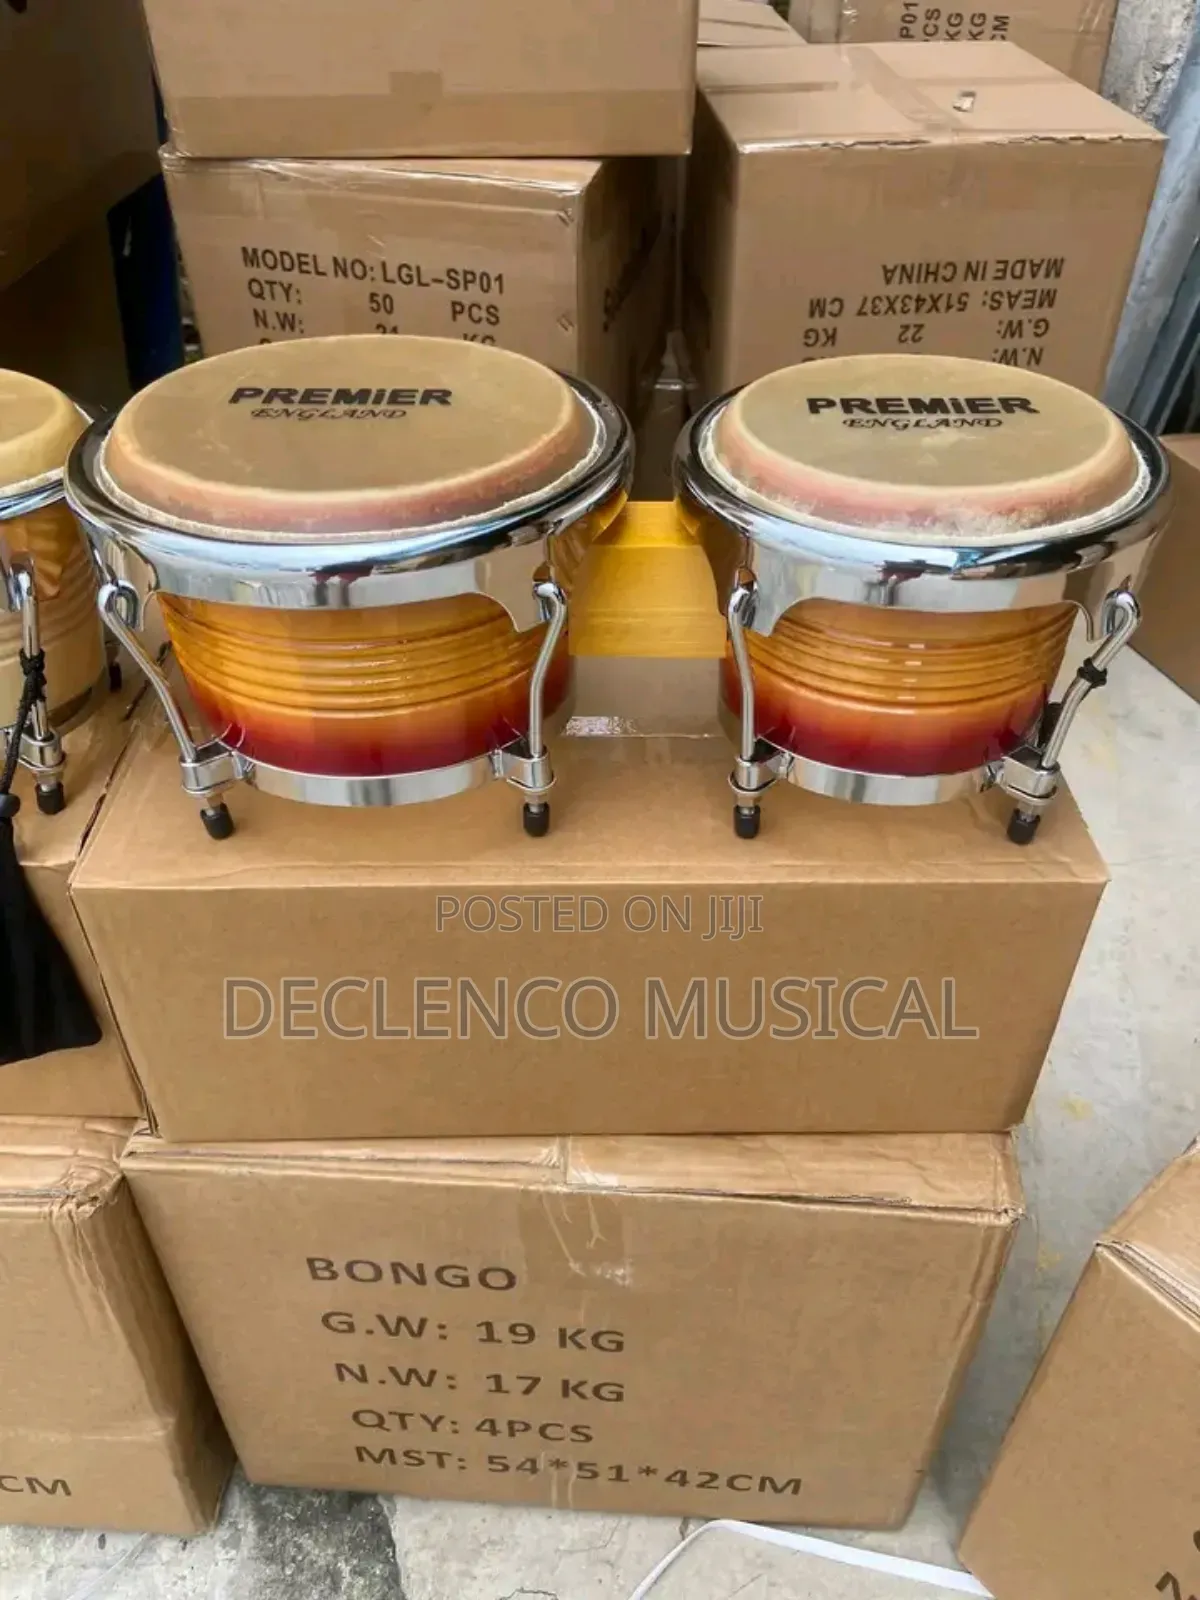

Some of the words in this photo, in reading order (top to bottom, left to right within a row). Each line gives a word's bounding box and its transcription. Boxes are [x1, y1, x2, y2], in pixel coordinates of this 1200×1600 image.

[922, 8, 941, 42] CS
[241, 246, 327, 277] MODEL
[382, 260, 505, 295] LGL-SP01
[881, 261, 957, 286] CHINA
[963, 260, 987, 282] IN
[993, 257, 1064, 281] MADE
[247, 277, 302, 305] QTY:
[369, 291, 394, 315] 50
[450, 299, 500, 327] PCS
[808, 297, 844, 319] CM
[856, 292, 970, 317] 51X43X37
[981, 288, 1057, 312] MEAS:
[253, 307, 304, 334] N.W:
[897, 323, 925, 343] 22
[803, 326, 838, 348] KG
[251, 407, 407, 420] ENGLAND
[843, 417, 1003, 430] ENGLAND
[306, 1257, 517, 1291] BONGO
[321, 1311, 448, 1340] G.W:
[476, 1321, 536, 1345] 19
[558, 1327, 625, 1353] KG
[334, 1363, 458, 1390] N.W:
[486, 1374, 541, 1396] 17
[561, 1379, 625, 1403] KG
[351, 1409, 460, 1435] QTY:
[475, 1417, 594, 1444] 4PCS
[355, 1446, 468, 1471] MST:
